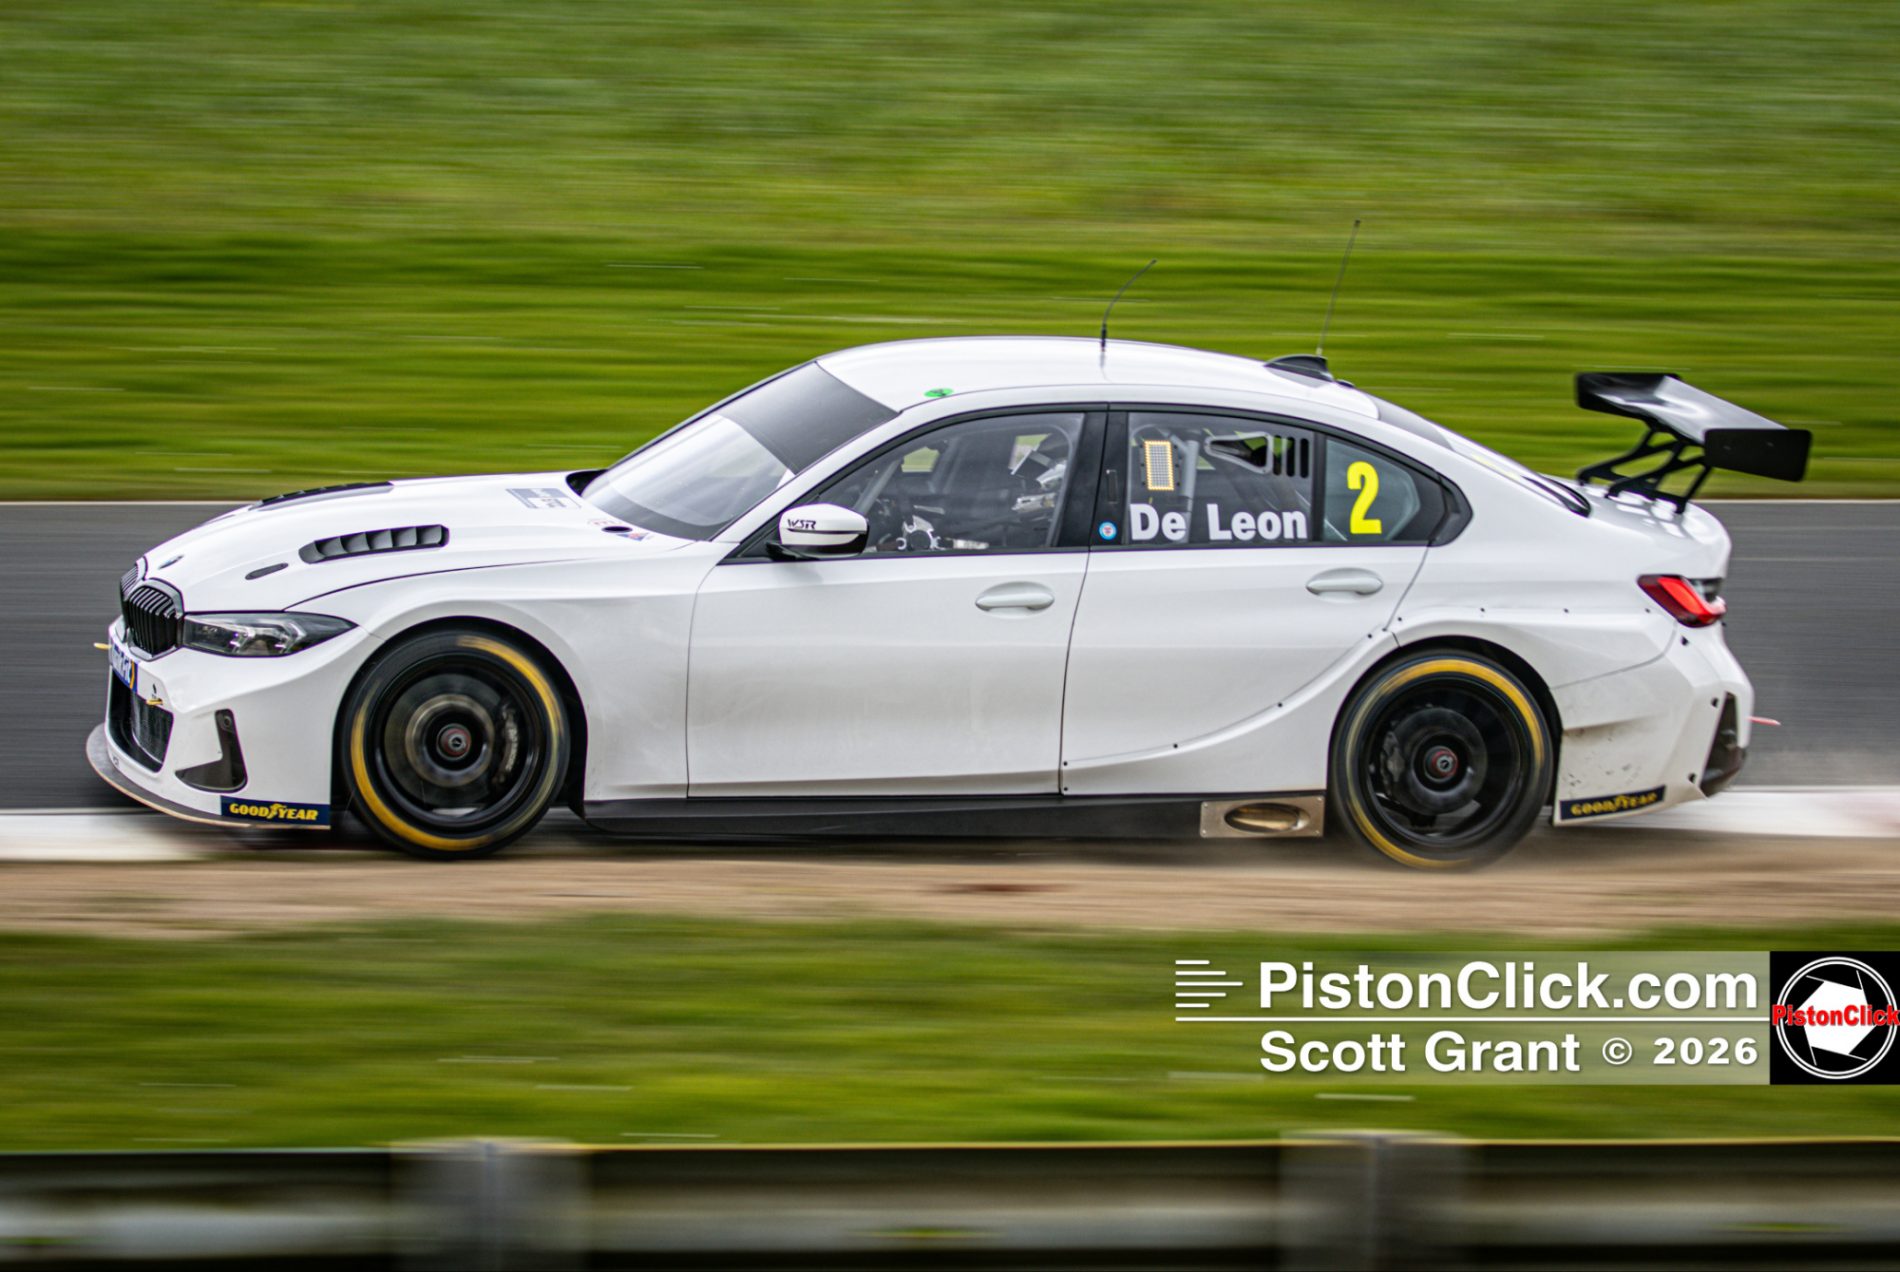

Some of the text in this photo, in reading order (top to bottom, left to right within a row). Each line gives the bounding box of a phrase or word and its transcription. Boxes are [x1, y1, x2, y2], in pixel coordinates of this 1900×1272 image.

[1347, 461, 1382, 534] 2
[1129, 503, 1187, 541] De
[1207, 503, 1307, 541] Leon
[229, 803, 318, 820] GOODYEAR
